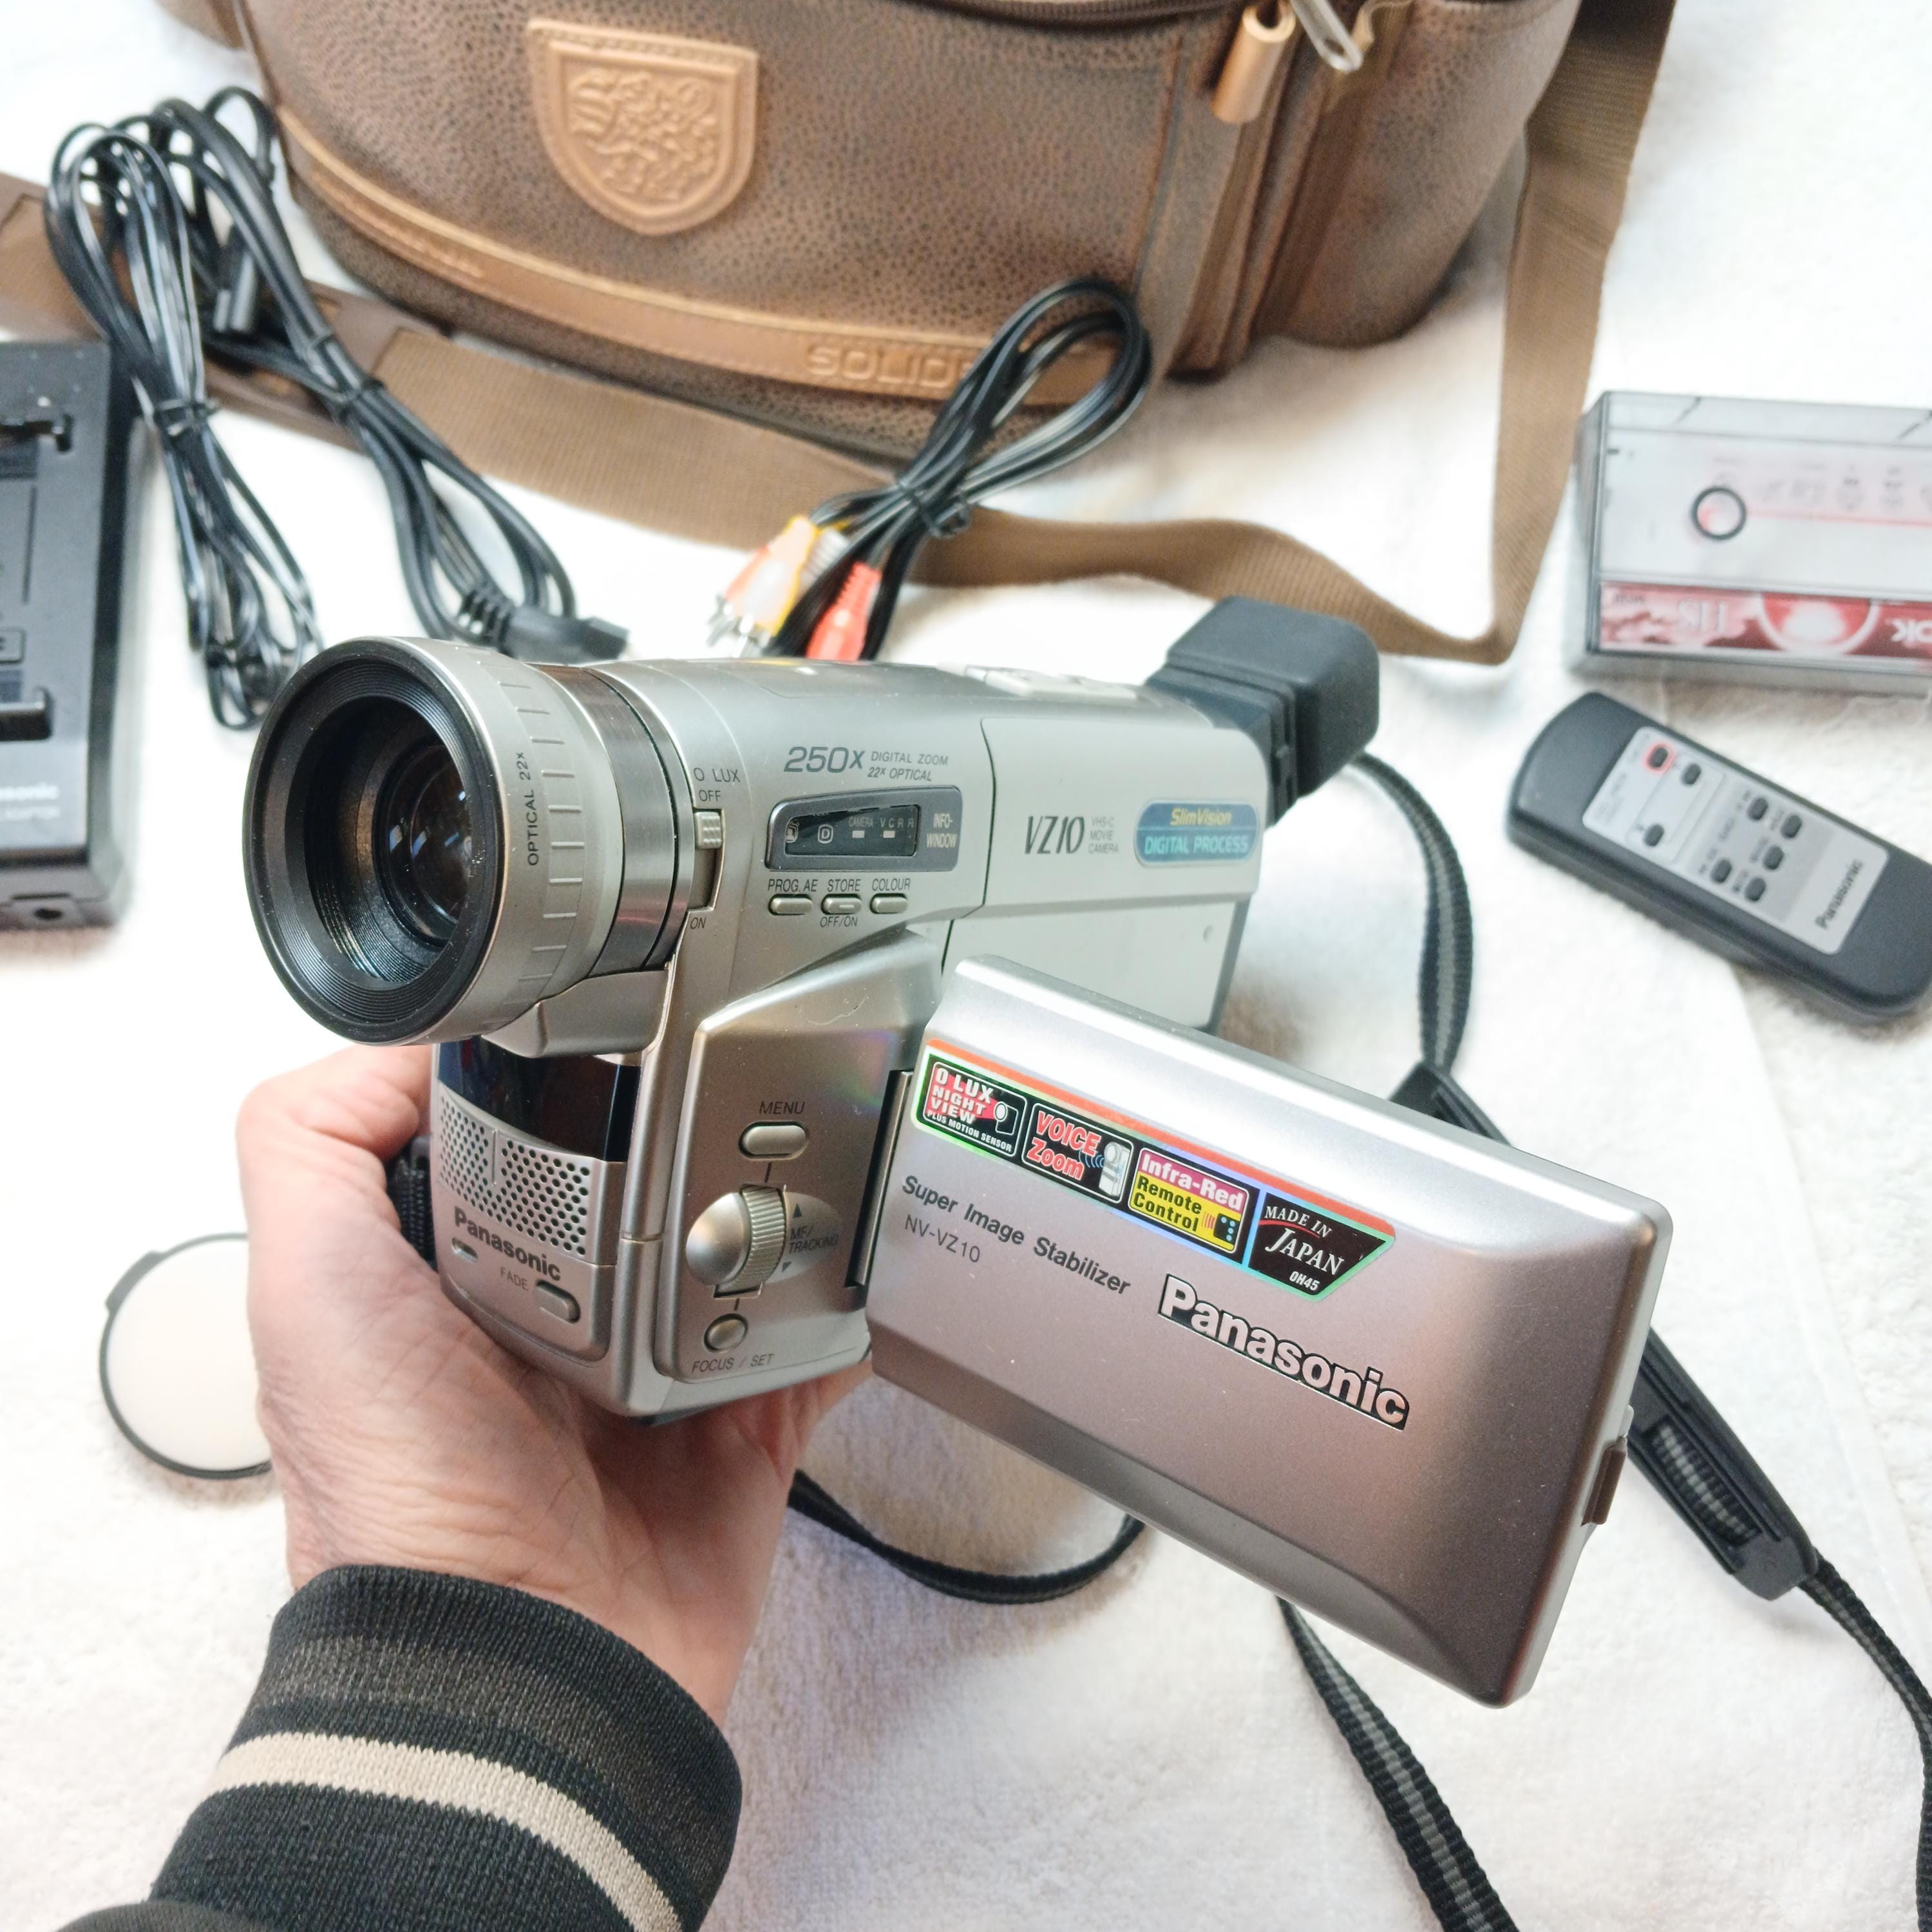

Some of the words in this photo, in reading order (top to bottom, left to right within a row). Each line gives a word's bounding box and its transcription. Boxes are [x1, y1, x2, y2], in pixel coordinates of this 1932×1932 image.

[1890, 619, 1932, 645] DK
[871, 751, 912, 763] DIGITAL
[917, 753, 948, 765] ZOOM
[713, 768, 741, 782] LUX
[889, 768, 932, 781] OPTICAL
[698, 790, 721, 802] OFF
[524, 789, 539, 866] OPTICAL
[1170, 808, 1232, 826] SlimVision
[926, 833, 957, 848] WINDOW
[1024, 815, 1084, 855] VZ10
[1090, 830, 1113, 840] MOVIE
[1144, 837, 1189, 855] DIGITAL
[1193, 836, 1248, 854] PROCESS
[1088, 843, 1119, 854] CAMERA
[828, 879, 861, 891] STORE
[872, 878, 911, 891] COLOUR
[1815, 859, 1864, 930] Panasonic
[690, 918, 706, 929] ON
[820, 916, 858, 927] OFF/ON
[933, 1084, 987, 1116] NIGHT
[953, 1079, 994, 1104] LUX
[759, 1102, 806, 1115] MENU
[931, 1097, 975, 1125] VIEW
[927, 1109, 947, 1124] PLUS
[948, 1117, 980, 1139] MOTION
[981, 1132, 1012, 1153] SENSOR
[1035, 1110, 1101, 1157] VOICE
[1027, 1137, 1085, 1181] Zoom
[1137, 1175, 1203, 1215] Remote
[1141, 1153, 1245, 1212] Infra-Red
[1133, 1191, 1199, 1233] Control
[1264, 1205, 1310, 1226] MADE
[1312, 1218, 1333, 1238] IN
[455, 1206, 561, 1281] Panasonic
[788, 1235, 838, 1254] TRACKING
[902, 1175, 958, 1213] Super
[963, 1203, 1025, 1245] Image
[1033, 1236, 1131, 1295] Stabilizer
[904, 1213, 981, 1264] NV-VZ10
[1264, 1227, 1345, 1276] JAPAN
[500, 1267, 528, 1291] FADE
[691, 1358, 734, 1373] FOCUS
[750, 1354, 774, 1367] SET
[1158, 1273, 1410, 1431] Panasonic
